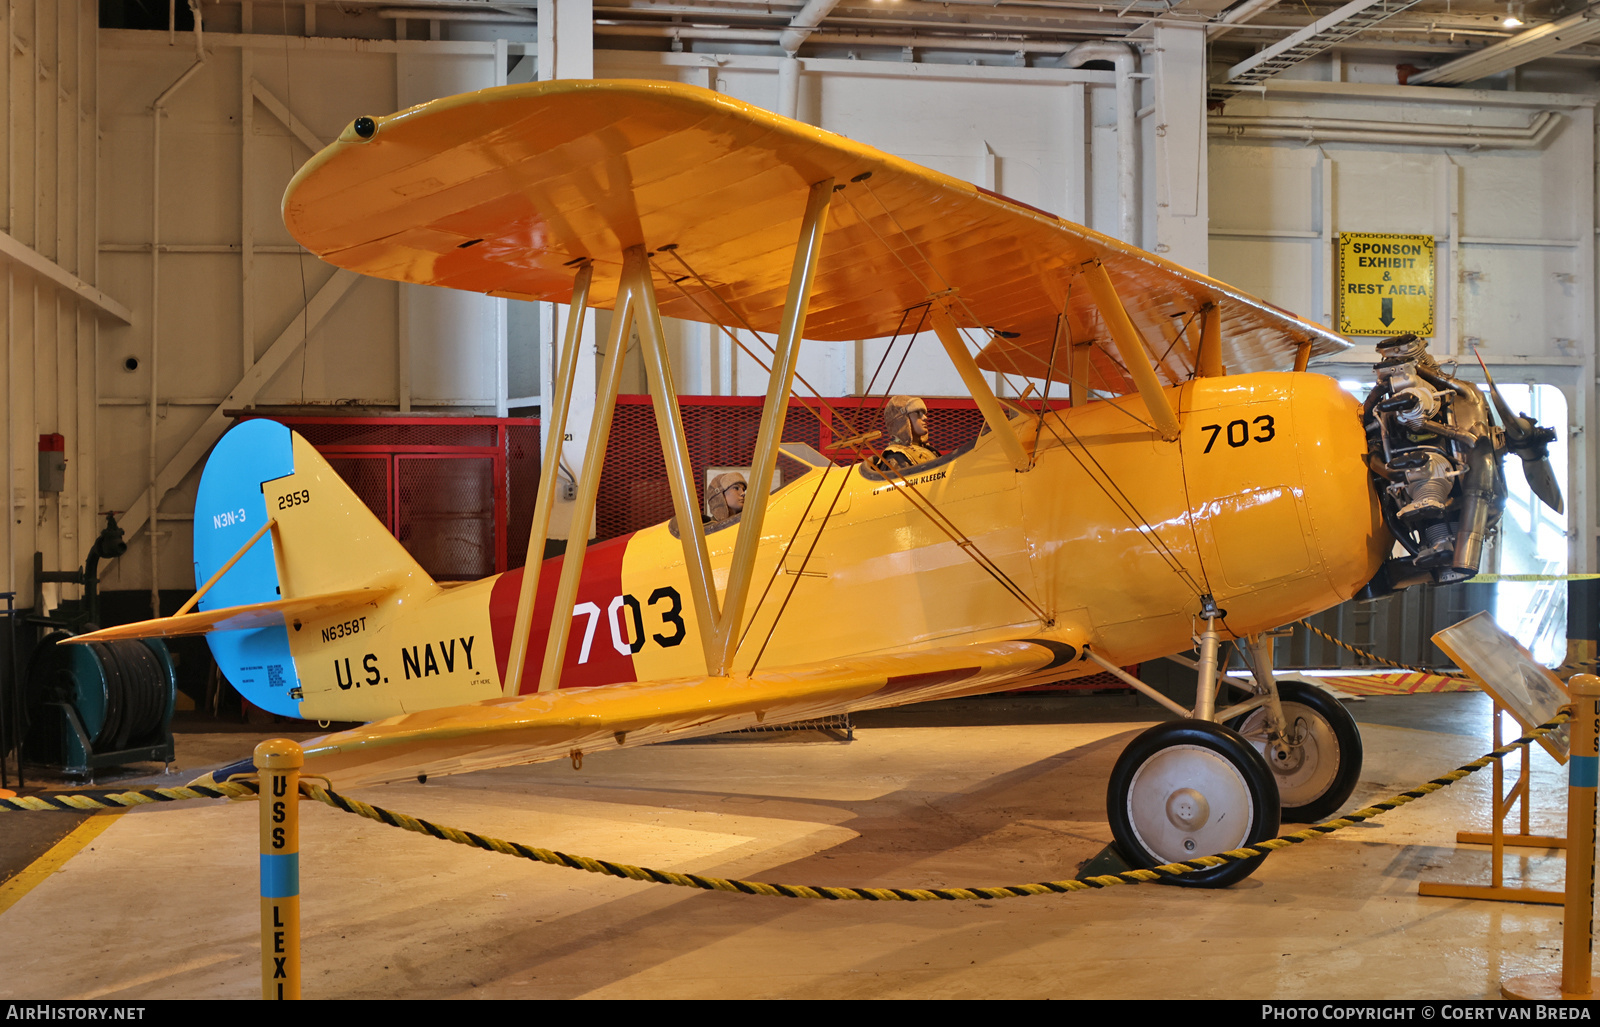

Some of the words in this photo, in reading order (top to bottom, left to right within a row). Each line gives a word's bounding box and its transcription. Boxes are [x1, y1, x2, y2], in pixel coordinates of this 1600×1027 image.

[1353, 243, 1421, 255] SPONSON
[1359, 257, 1416, 268] EXHIBIT
[1382, 270, 1392, 281] &
[1348, 283, 1384, 294] REST
[1388, 284, 1427, 296] AREA
[1201, 414, 1275, 454] 703
[920, 471, 947, 484] KLEECK
[278, 489, 310, 510] 2959
[213, 508, 246, 529] N3N-3
[321, 616, 367, 643] N6358T
[572, 586, 686, 664] 703
[334, 653, 389, 691] U.S.
[401, 635, 475, 680] NAVY
[272, 776, 287, 849] USS
